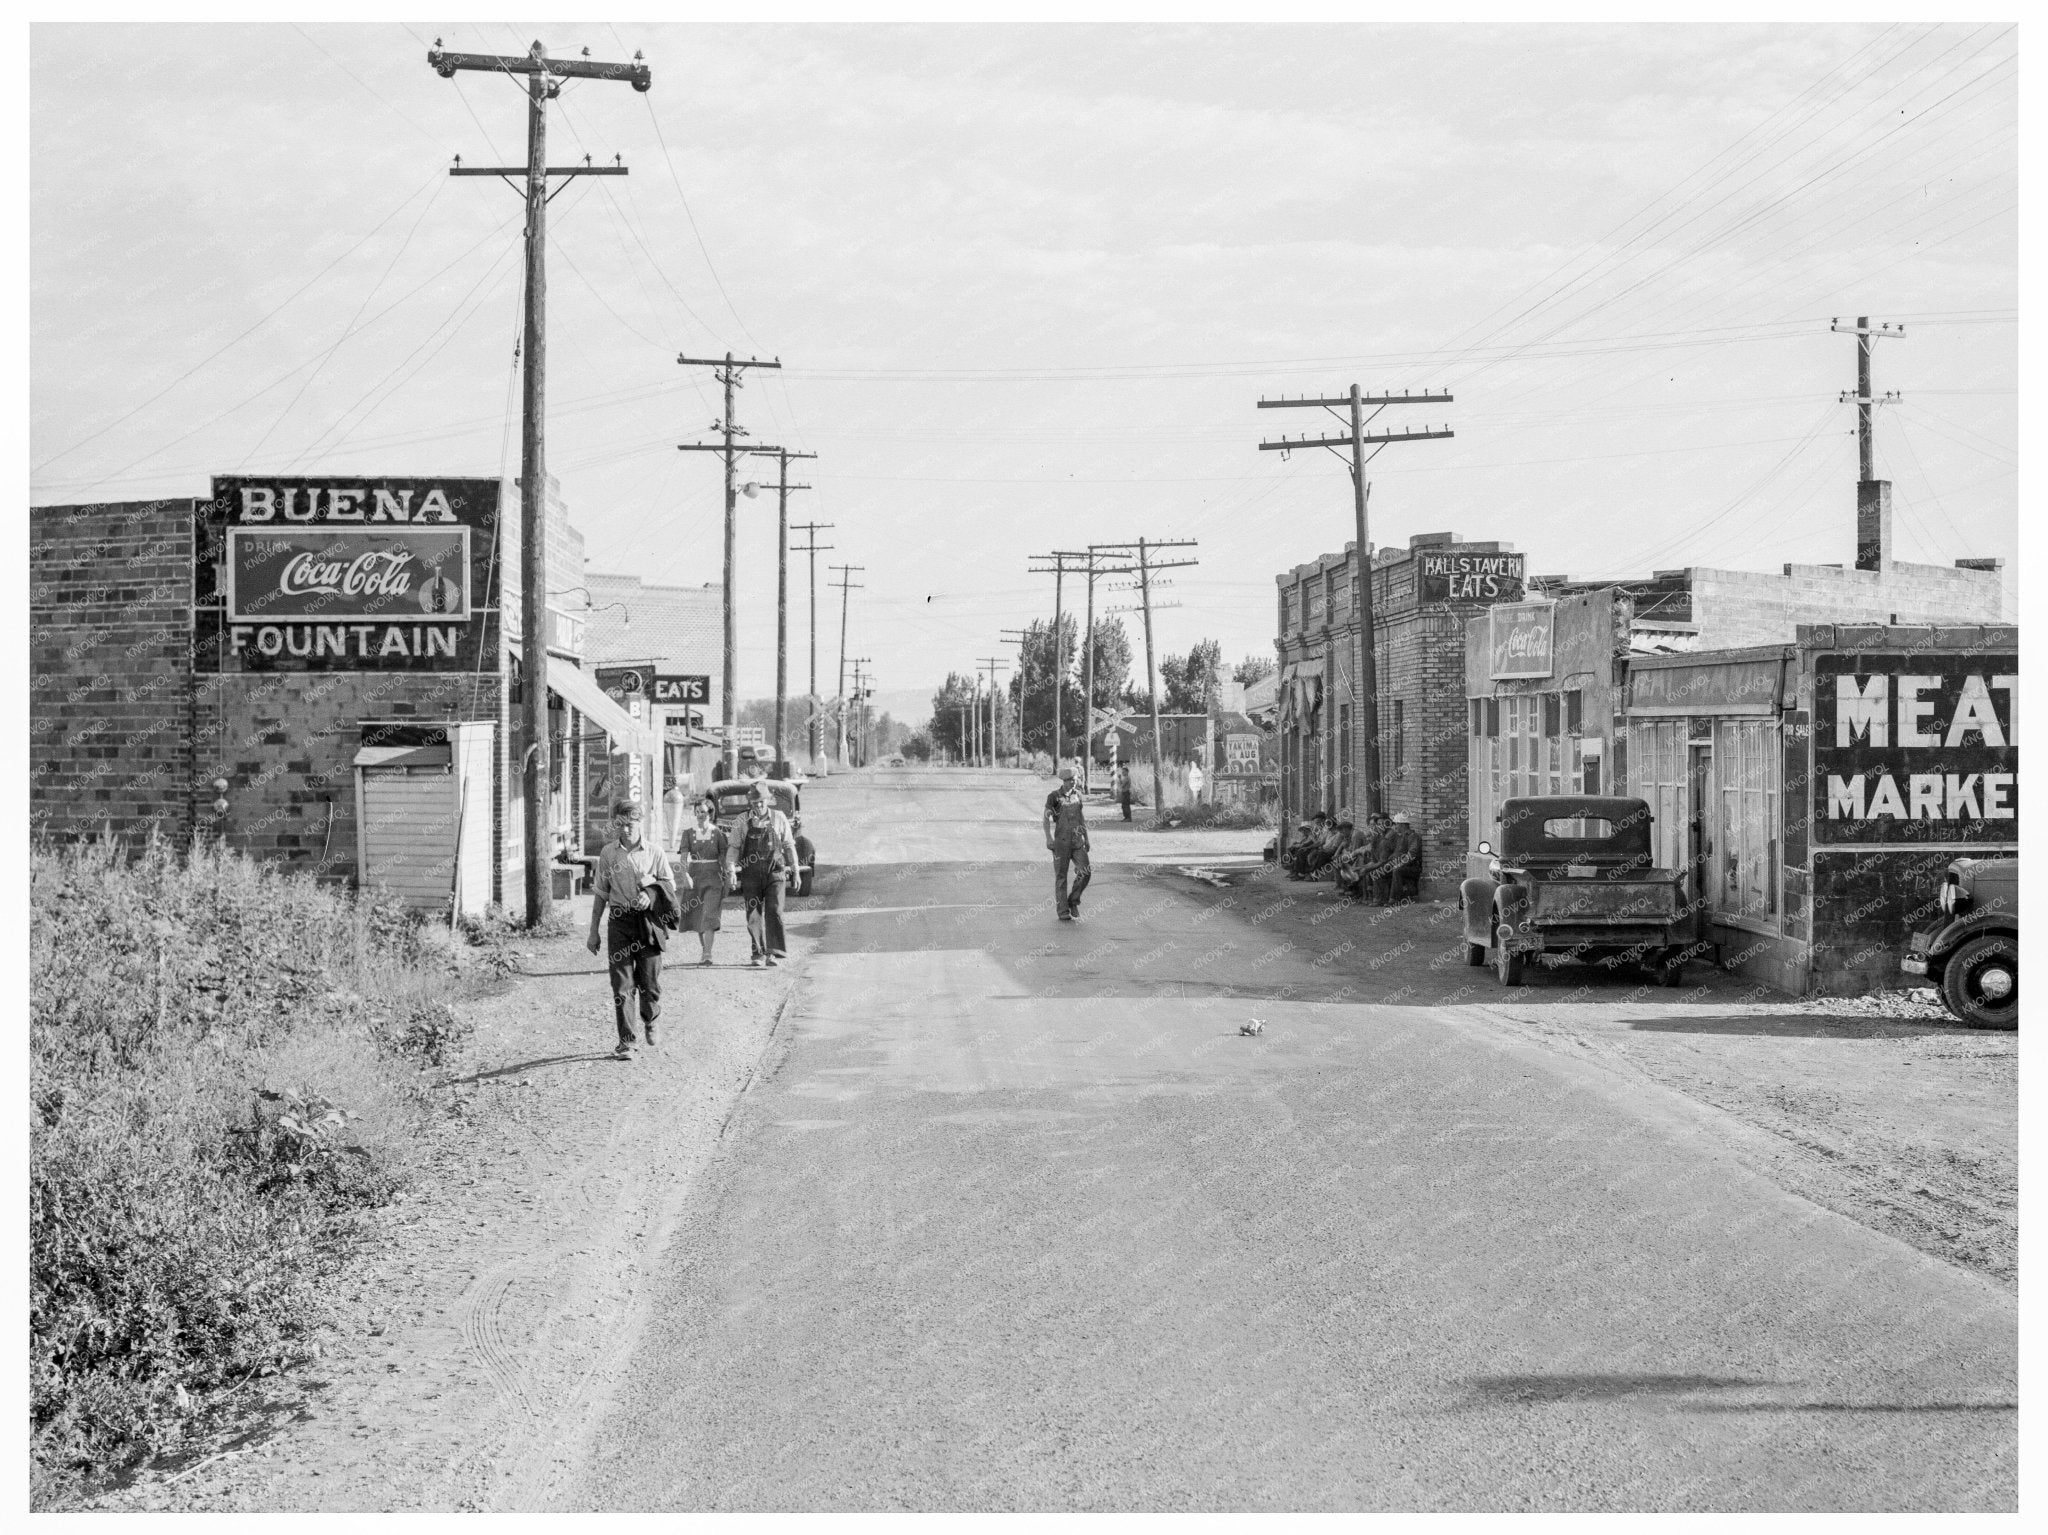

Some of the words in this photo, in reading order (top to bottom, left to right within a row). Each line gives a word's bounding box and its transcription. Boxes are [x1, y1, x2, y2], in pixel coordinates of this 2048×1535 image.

[240, 488, 457, 522] BUENA
[244, 541, 292, 552] DRINK
[280, 552, 415, 595] Coca-Cola
[1449, 574, 1499, 597] EATS
[231, 625, 456, 657] FOUNTAIN
[656, 681, 702, 698] EATS
[1828, 773, 2018, 819] MARKE
